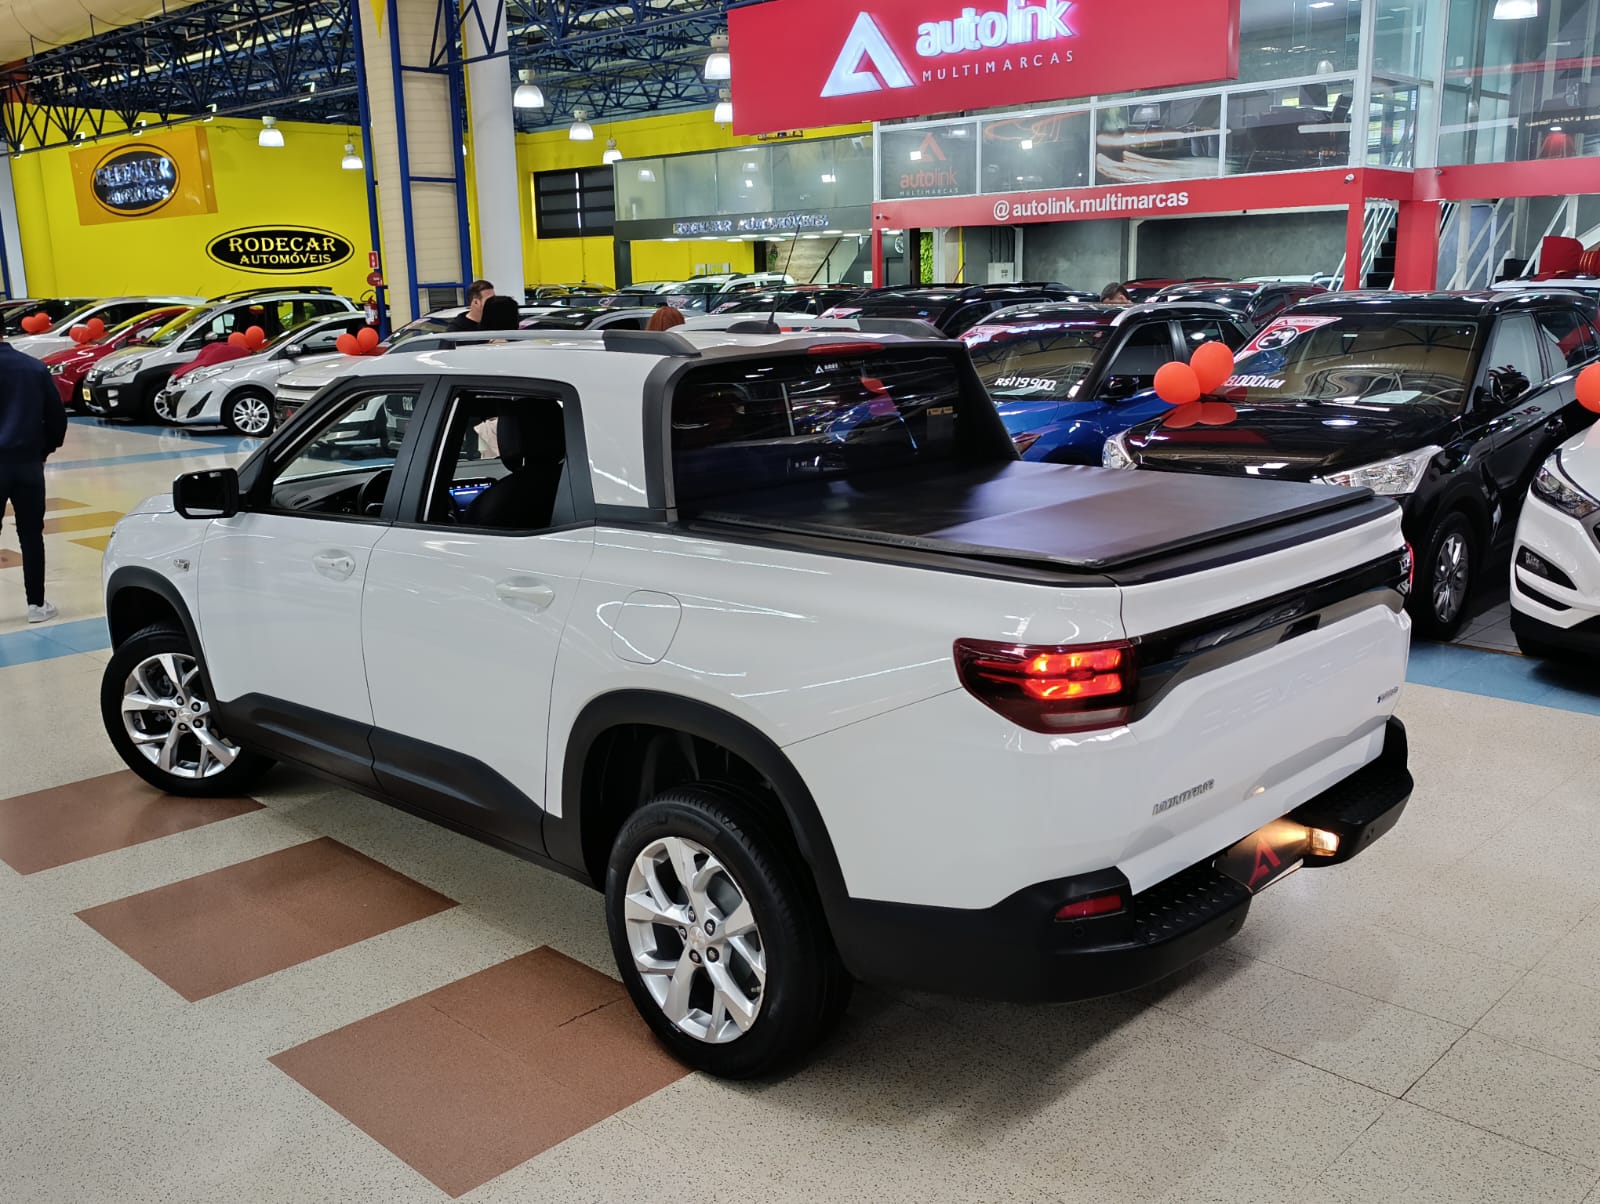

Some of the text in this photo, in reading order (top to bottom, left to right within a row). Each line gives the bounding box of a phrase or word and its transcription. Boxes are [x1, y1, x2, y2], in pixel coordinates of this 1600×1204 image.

[915, 0, 1073, 56] autolink
[922, 50, 1073, 82] MULTIMARCAS
[900, 167, 959, 189] autolink
[993, 191, 1190, 221] @autolink.multimarcas
[228, 236, 337, 253] RODECAR
[239, 252, 332, 265] AUTOMÓVEIS
